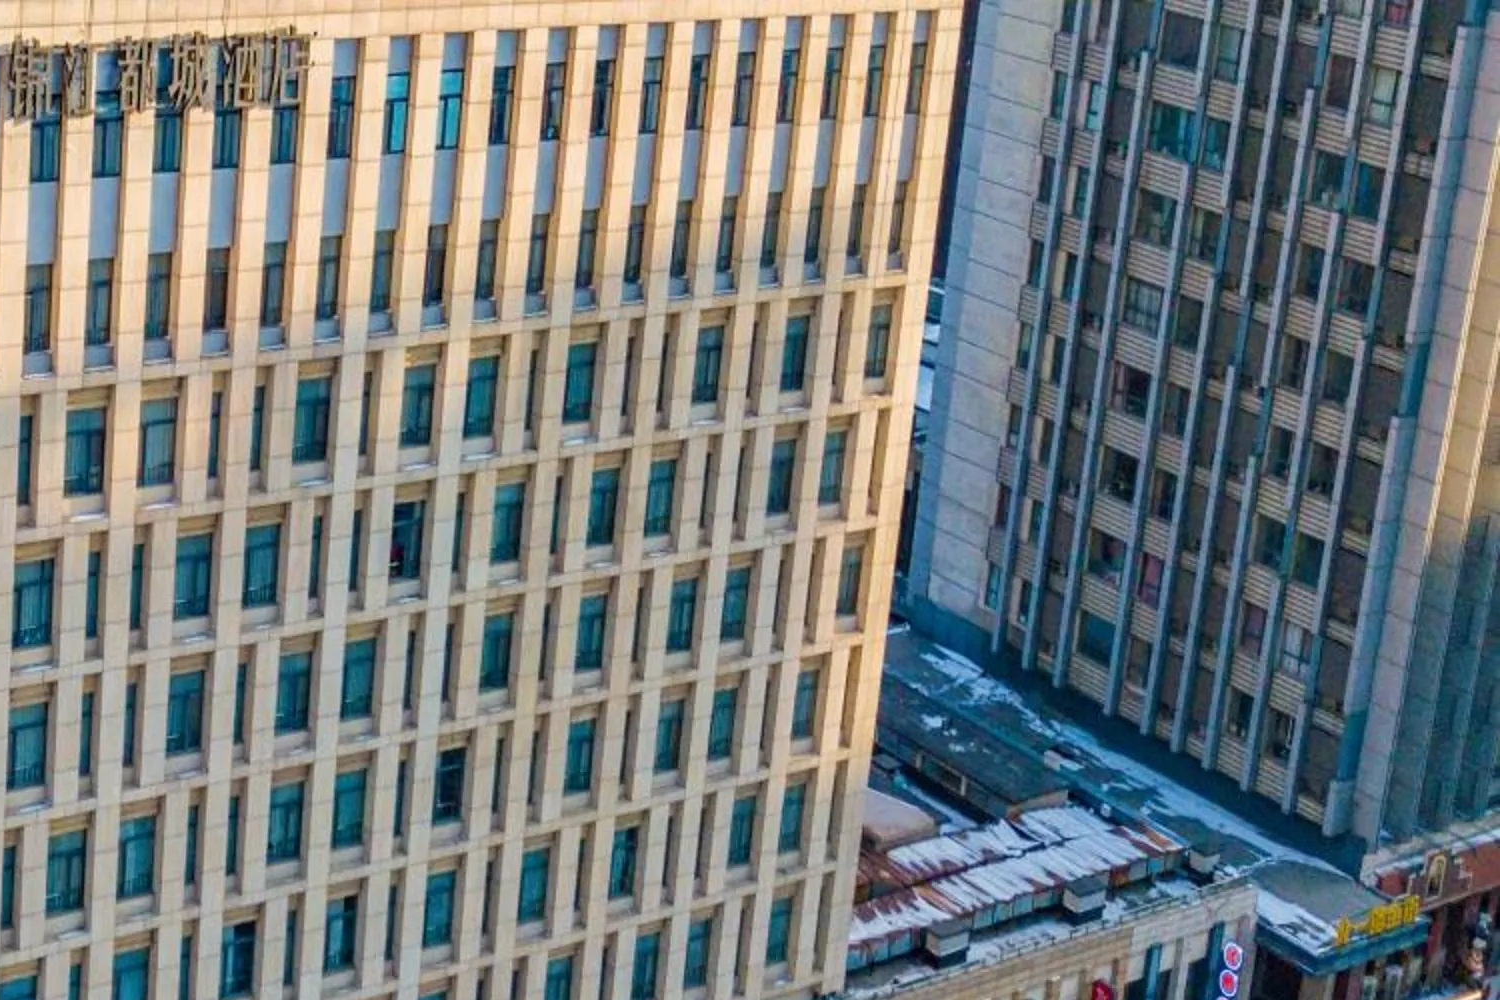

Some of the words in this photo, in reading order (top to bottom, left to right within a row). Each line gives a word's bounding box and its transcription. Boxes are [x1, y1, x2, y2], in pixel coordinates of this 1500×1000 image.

[8, 25, 311, 120] 锦江都城酒店
